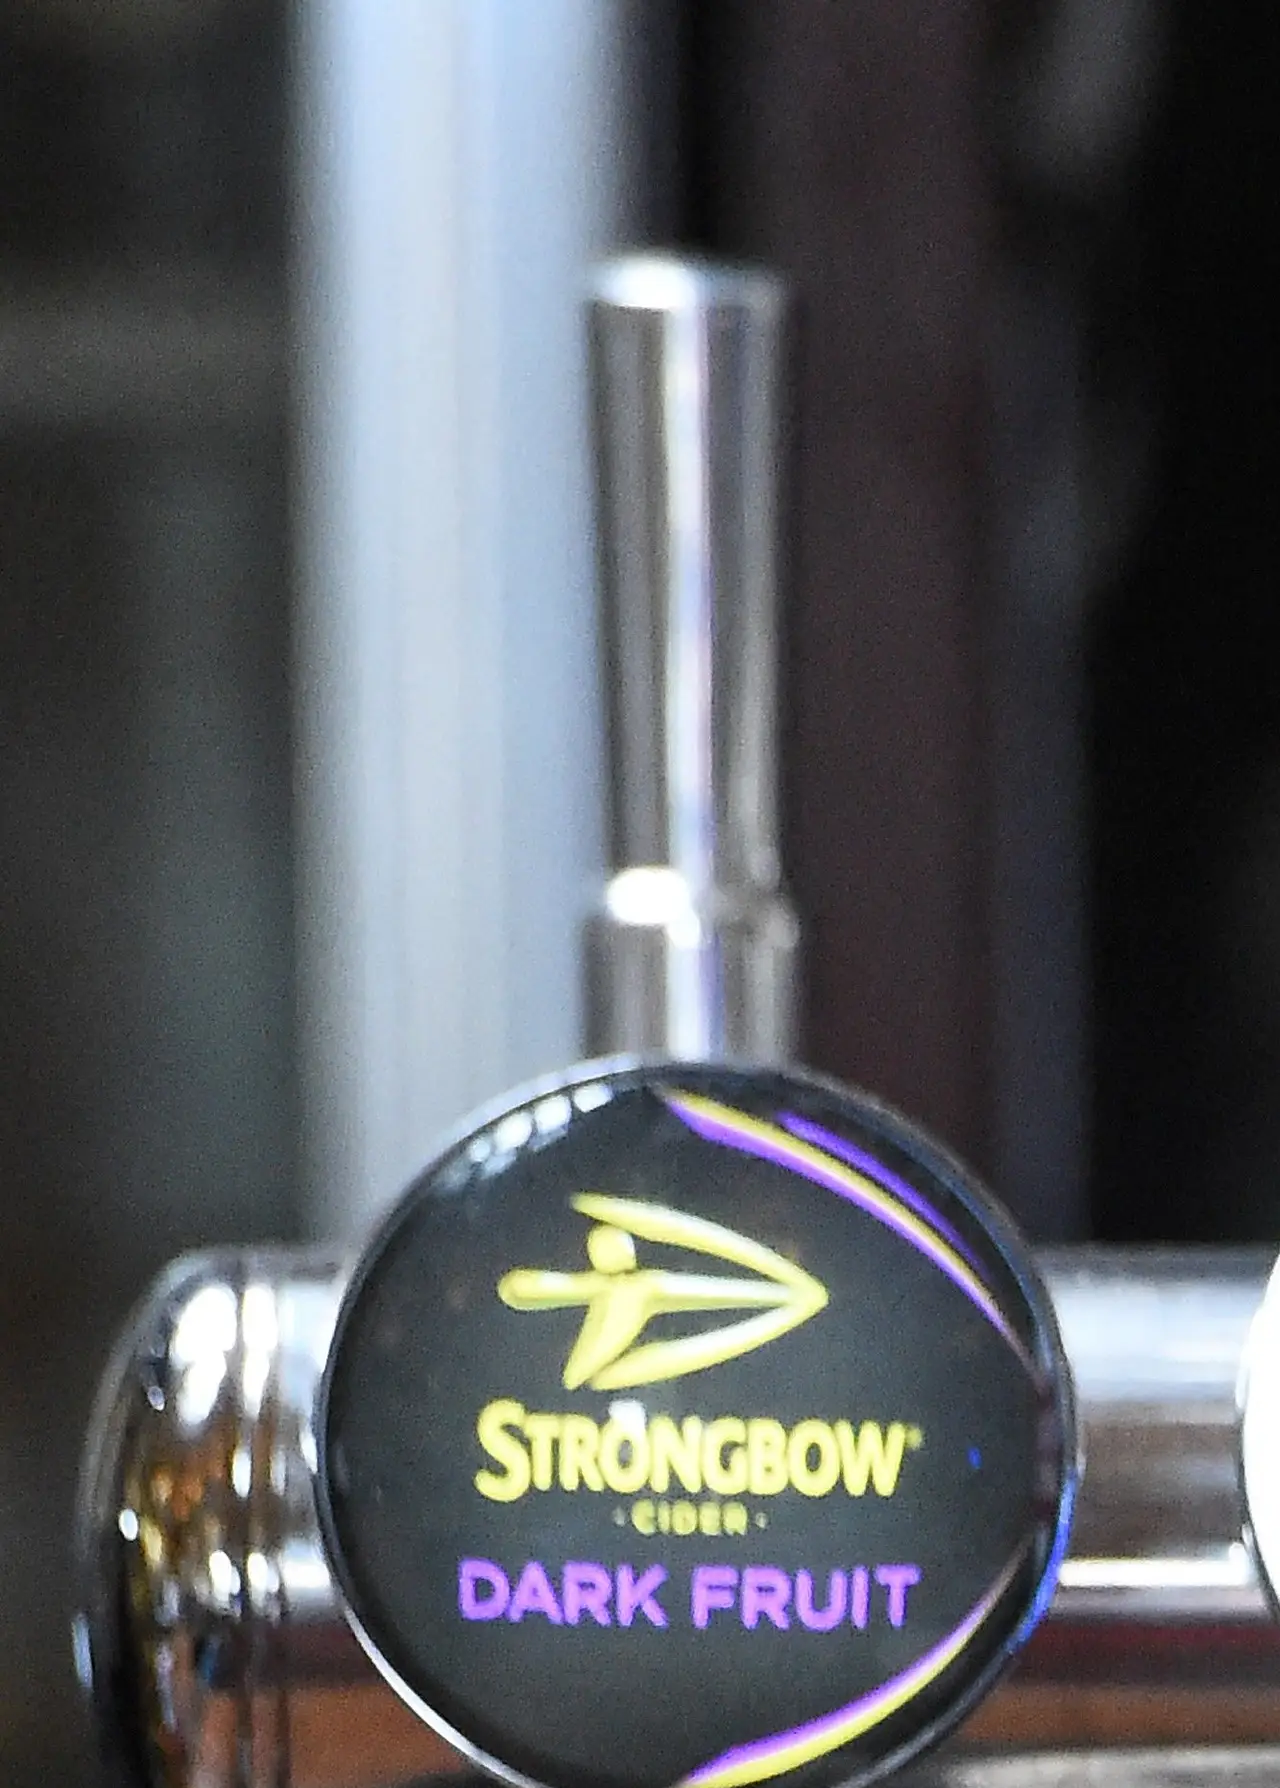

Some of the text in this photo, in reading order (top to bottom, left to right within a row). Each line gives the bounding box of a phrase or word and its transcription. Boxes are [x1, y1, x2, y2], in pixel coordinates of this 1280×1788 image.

[474, 1398, 906, 1502] STRONGBOW
[630, 1500, 748, 1536] CIDER
[457, 1557, 923, 1633] DARK FRUIT
